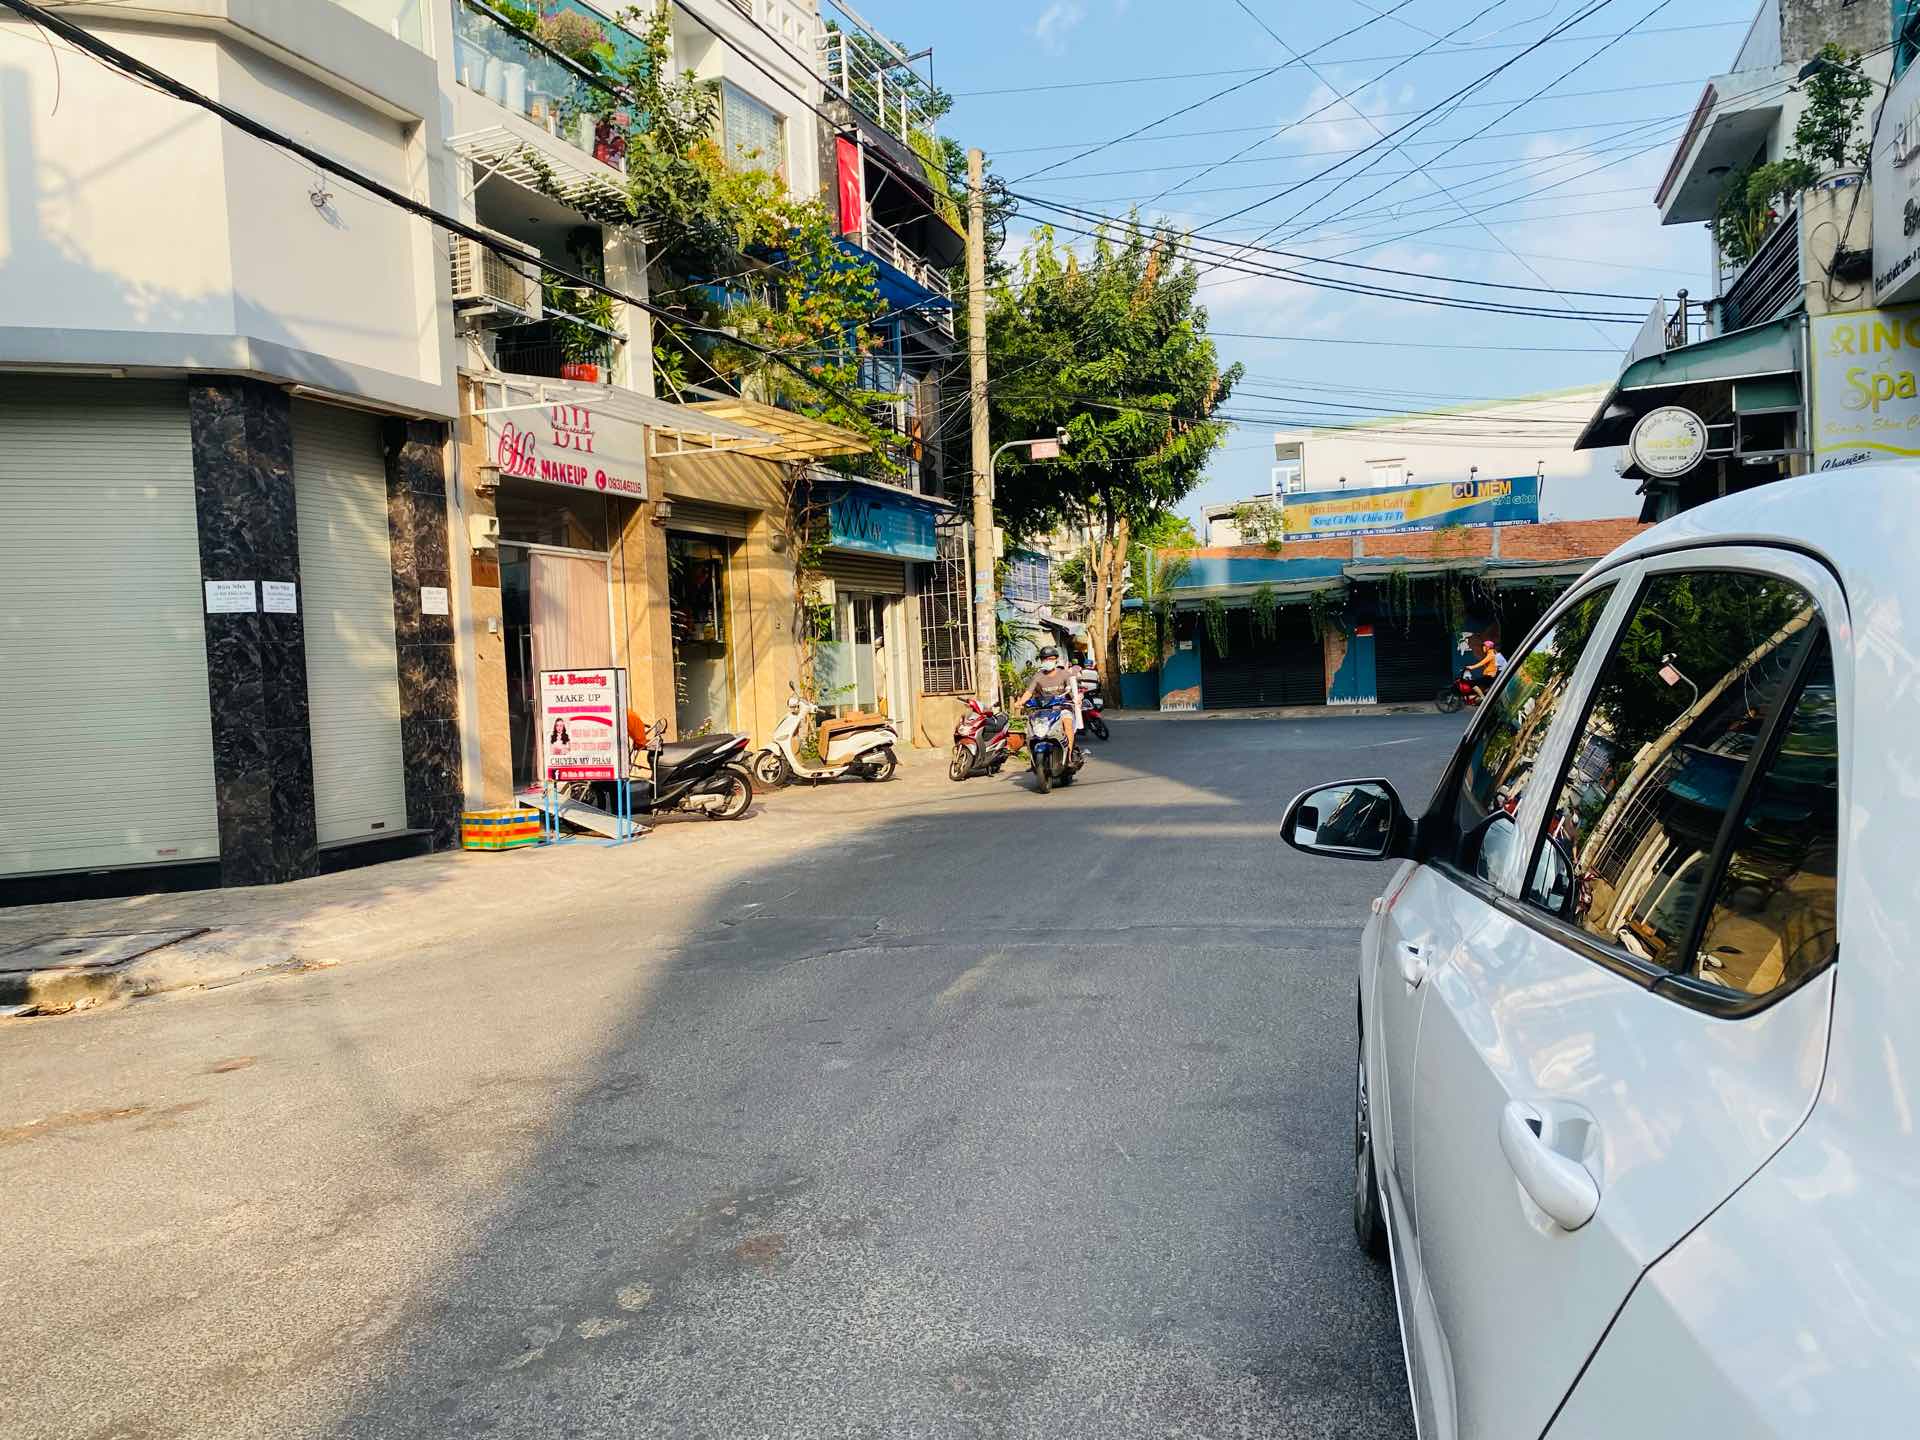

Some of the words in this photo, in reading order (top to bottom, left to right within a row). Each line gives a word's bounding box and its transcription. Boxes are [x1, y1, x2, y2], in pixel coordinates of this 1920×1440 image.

[1841, 367, 1918, 414] Spa
[541, 459, 588, 485] MAKEUP
[555, 694, 585, 703] MAKE
[588, 693, 601, 702] UP
